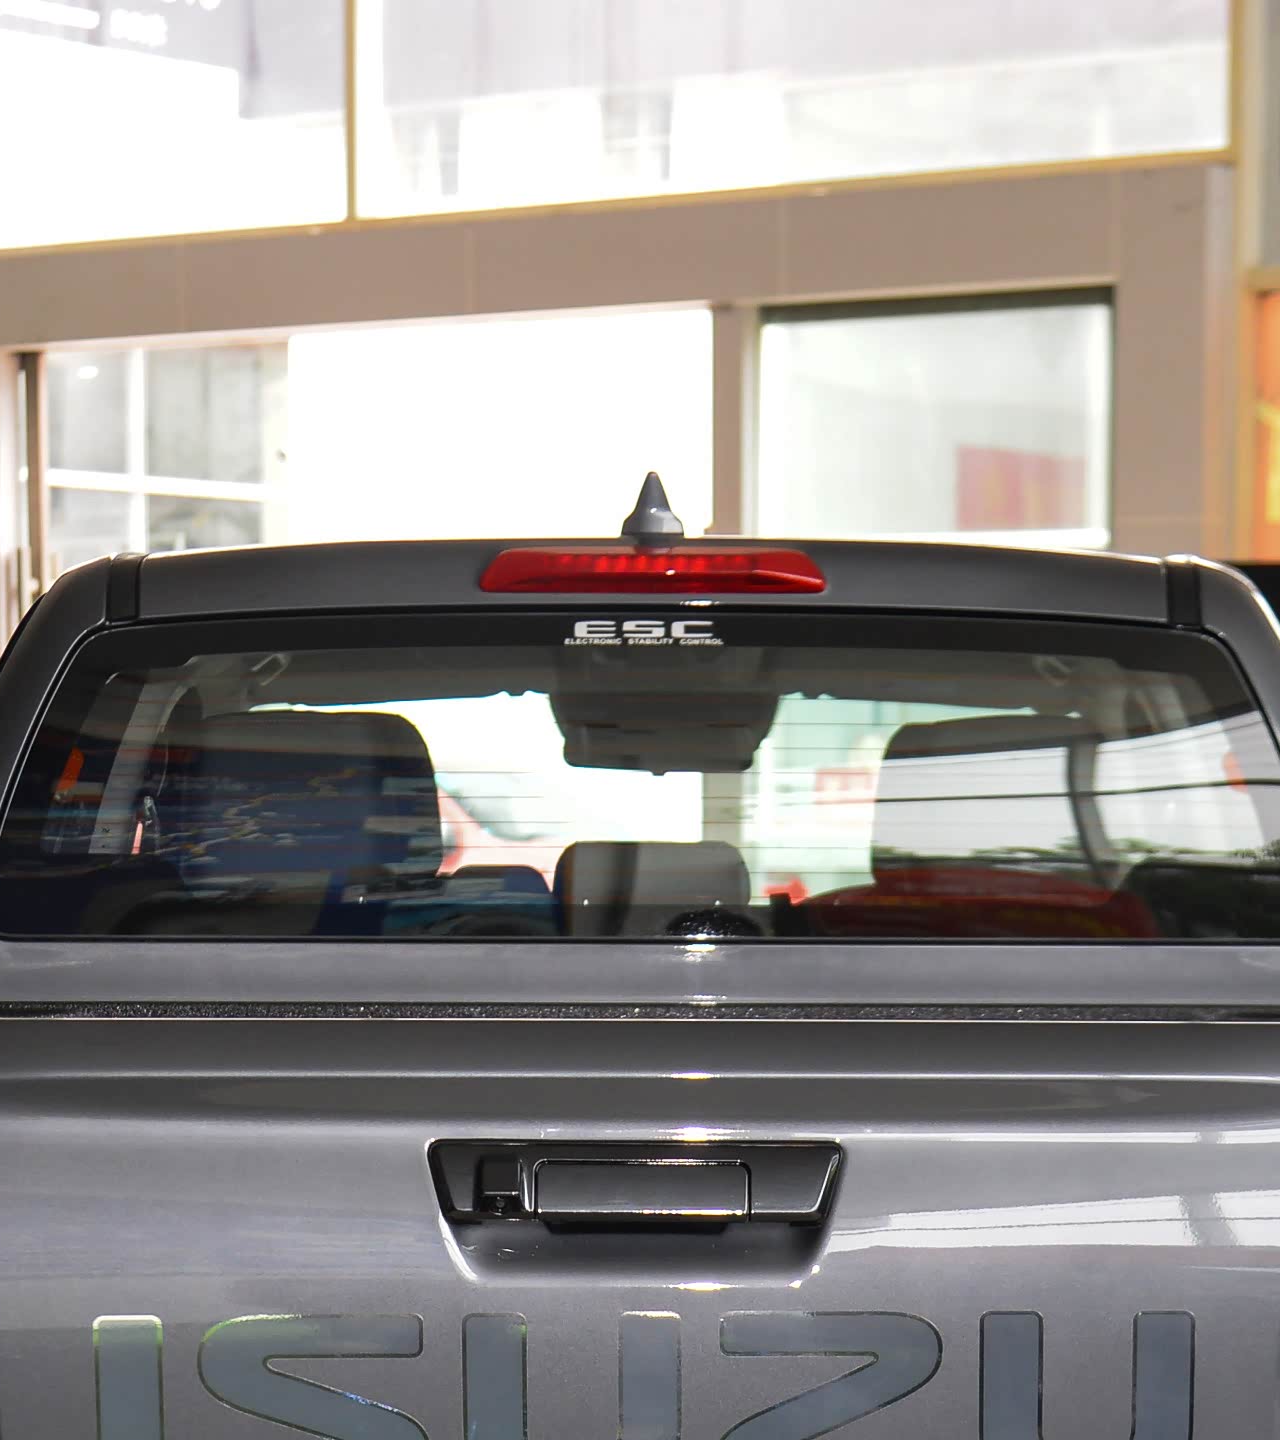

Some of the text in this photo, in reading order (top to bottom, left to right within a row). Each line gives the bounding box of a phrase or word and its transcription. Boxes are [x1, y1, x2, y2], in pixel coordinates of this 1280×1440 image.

[574, 620, 714, 638] ESC
[564, 637, 724, 646] ELECTRONIC STABILITY CONTROL
